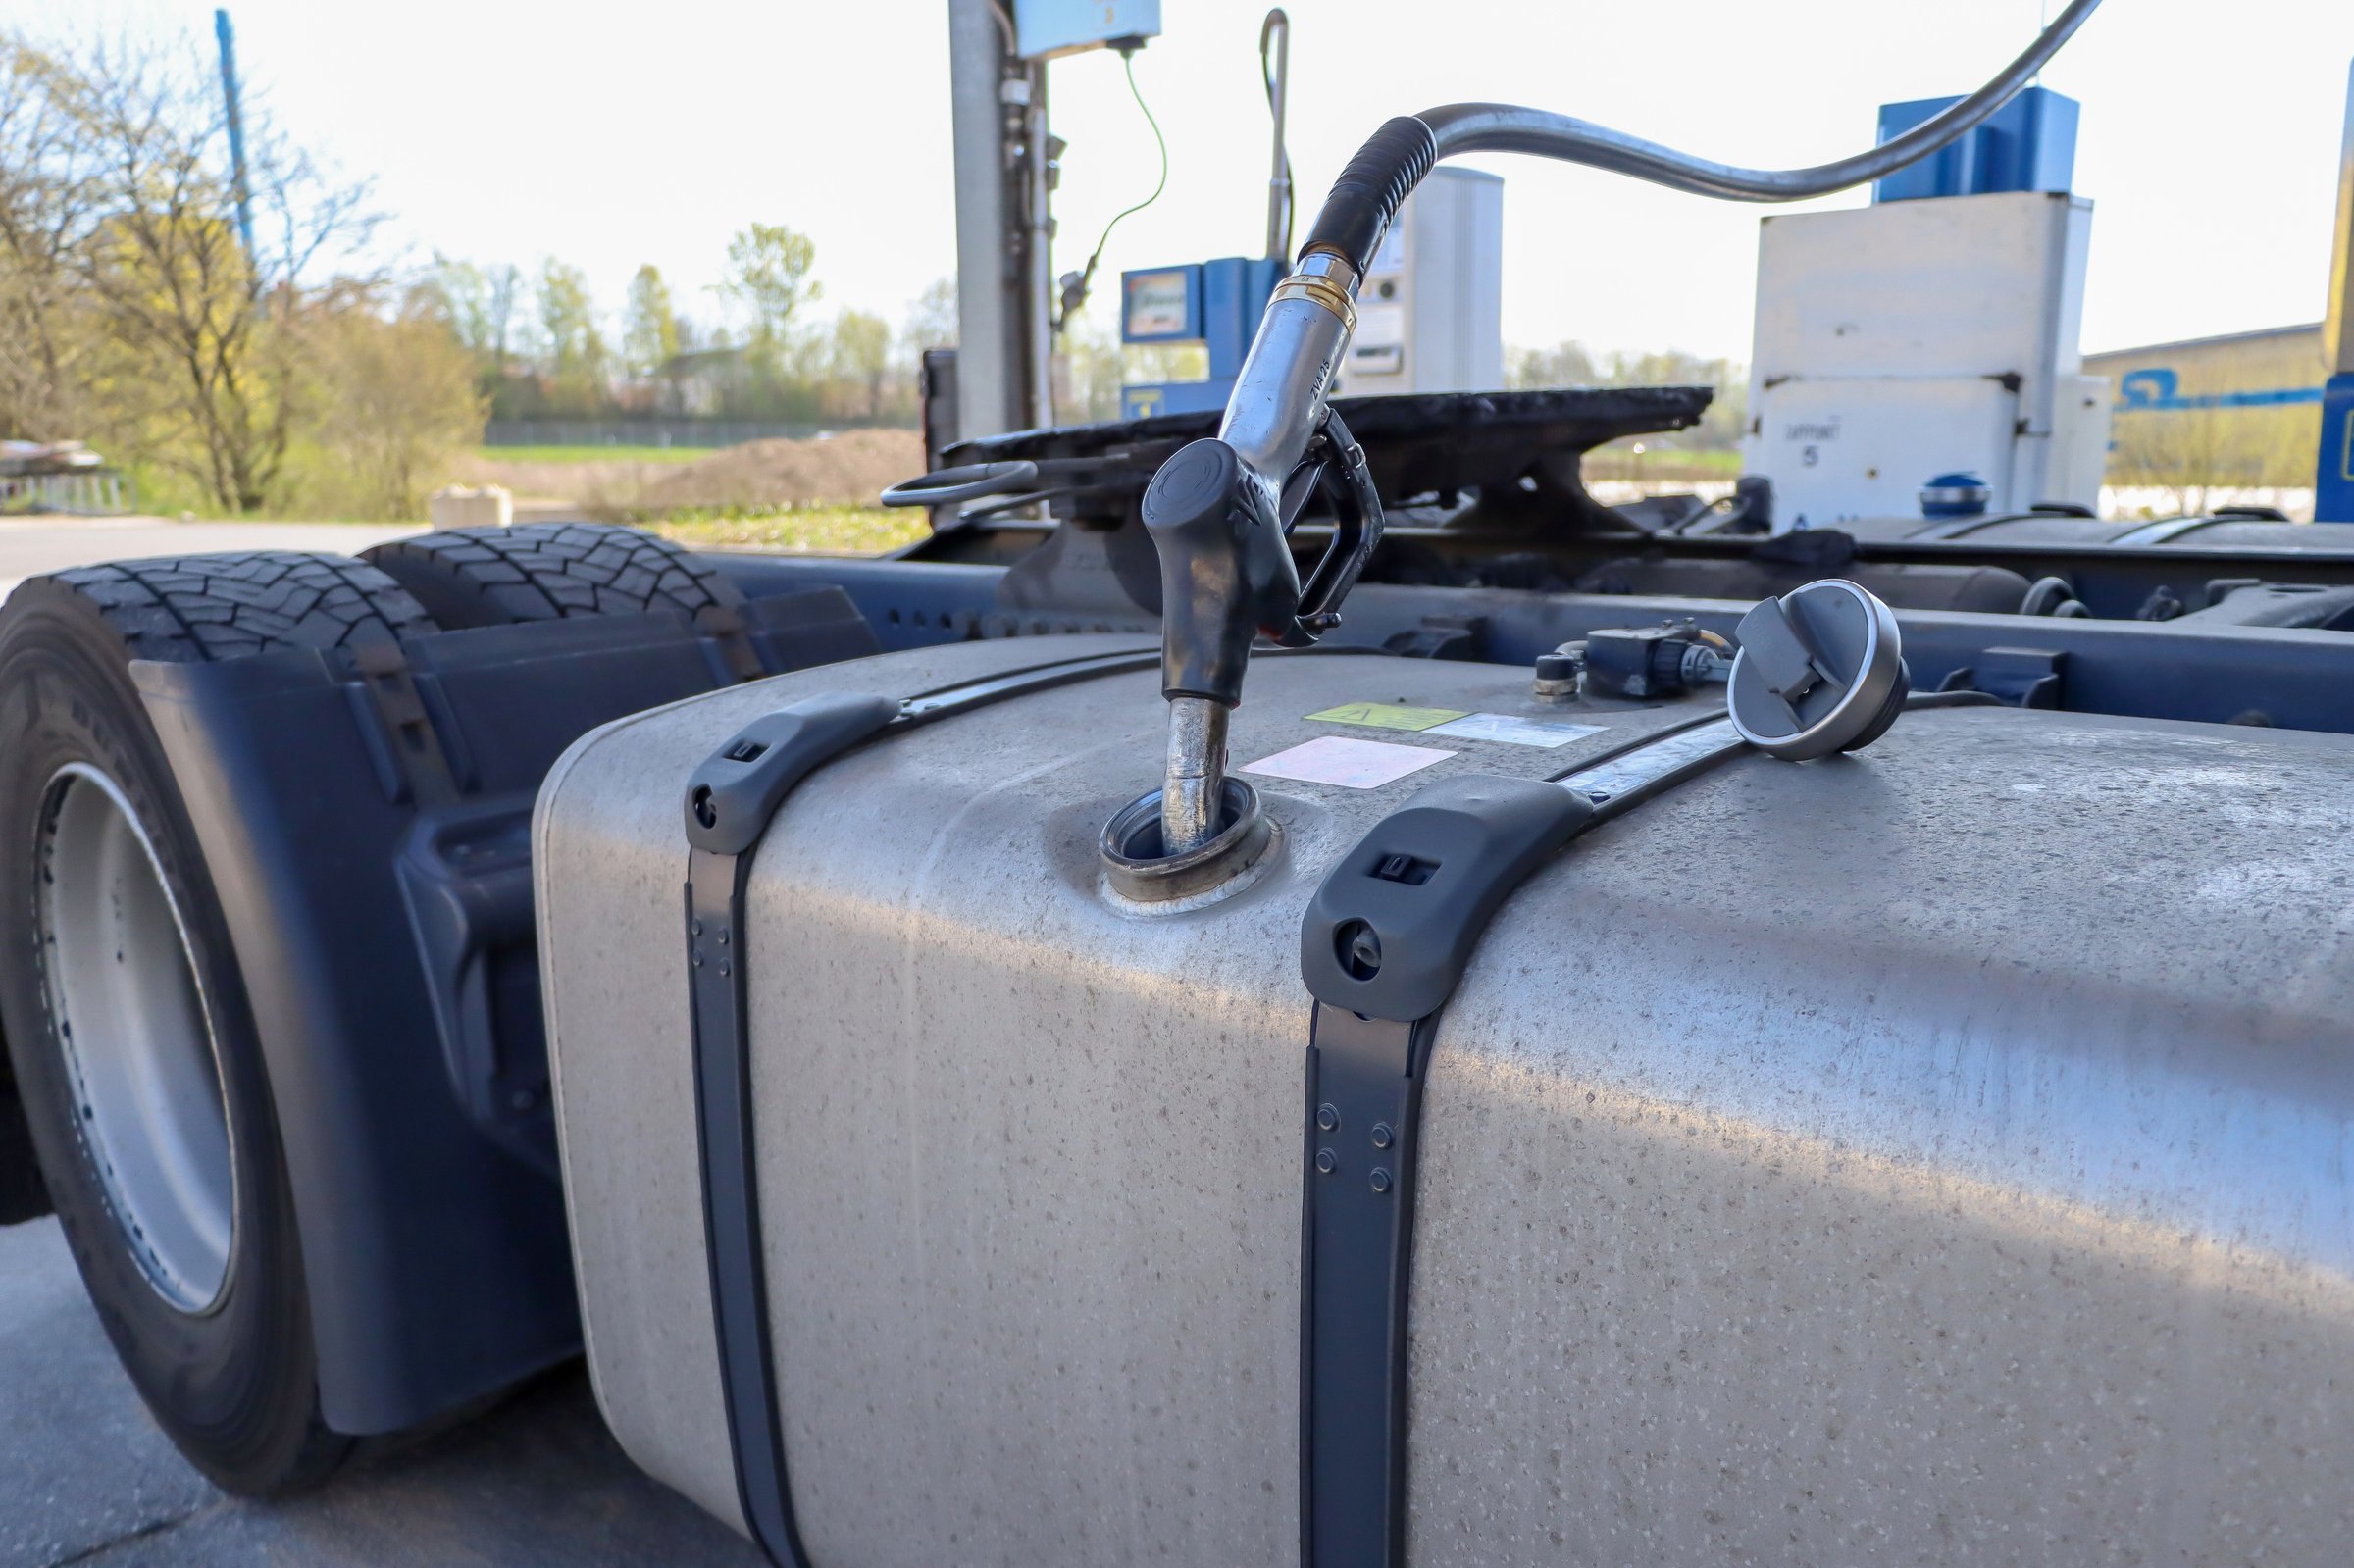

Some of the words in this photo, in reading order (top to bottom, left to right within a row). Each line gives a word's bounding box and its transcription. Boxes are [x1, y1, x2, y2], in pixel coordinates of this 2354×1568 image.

[1309, 376, 1323, 401] ZVA
[1320, 359, 1330, 378] 25
[1802, 445, 1819, 468] 5
